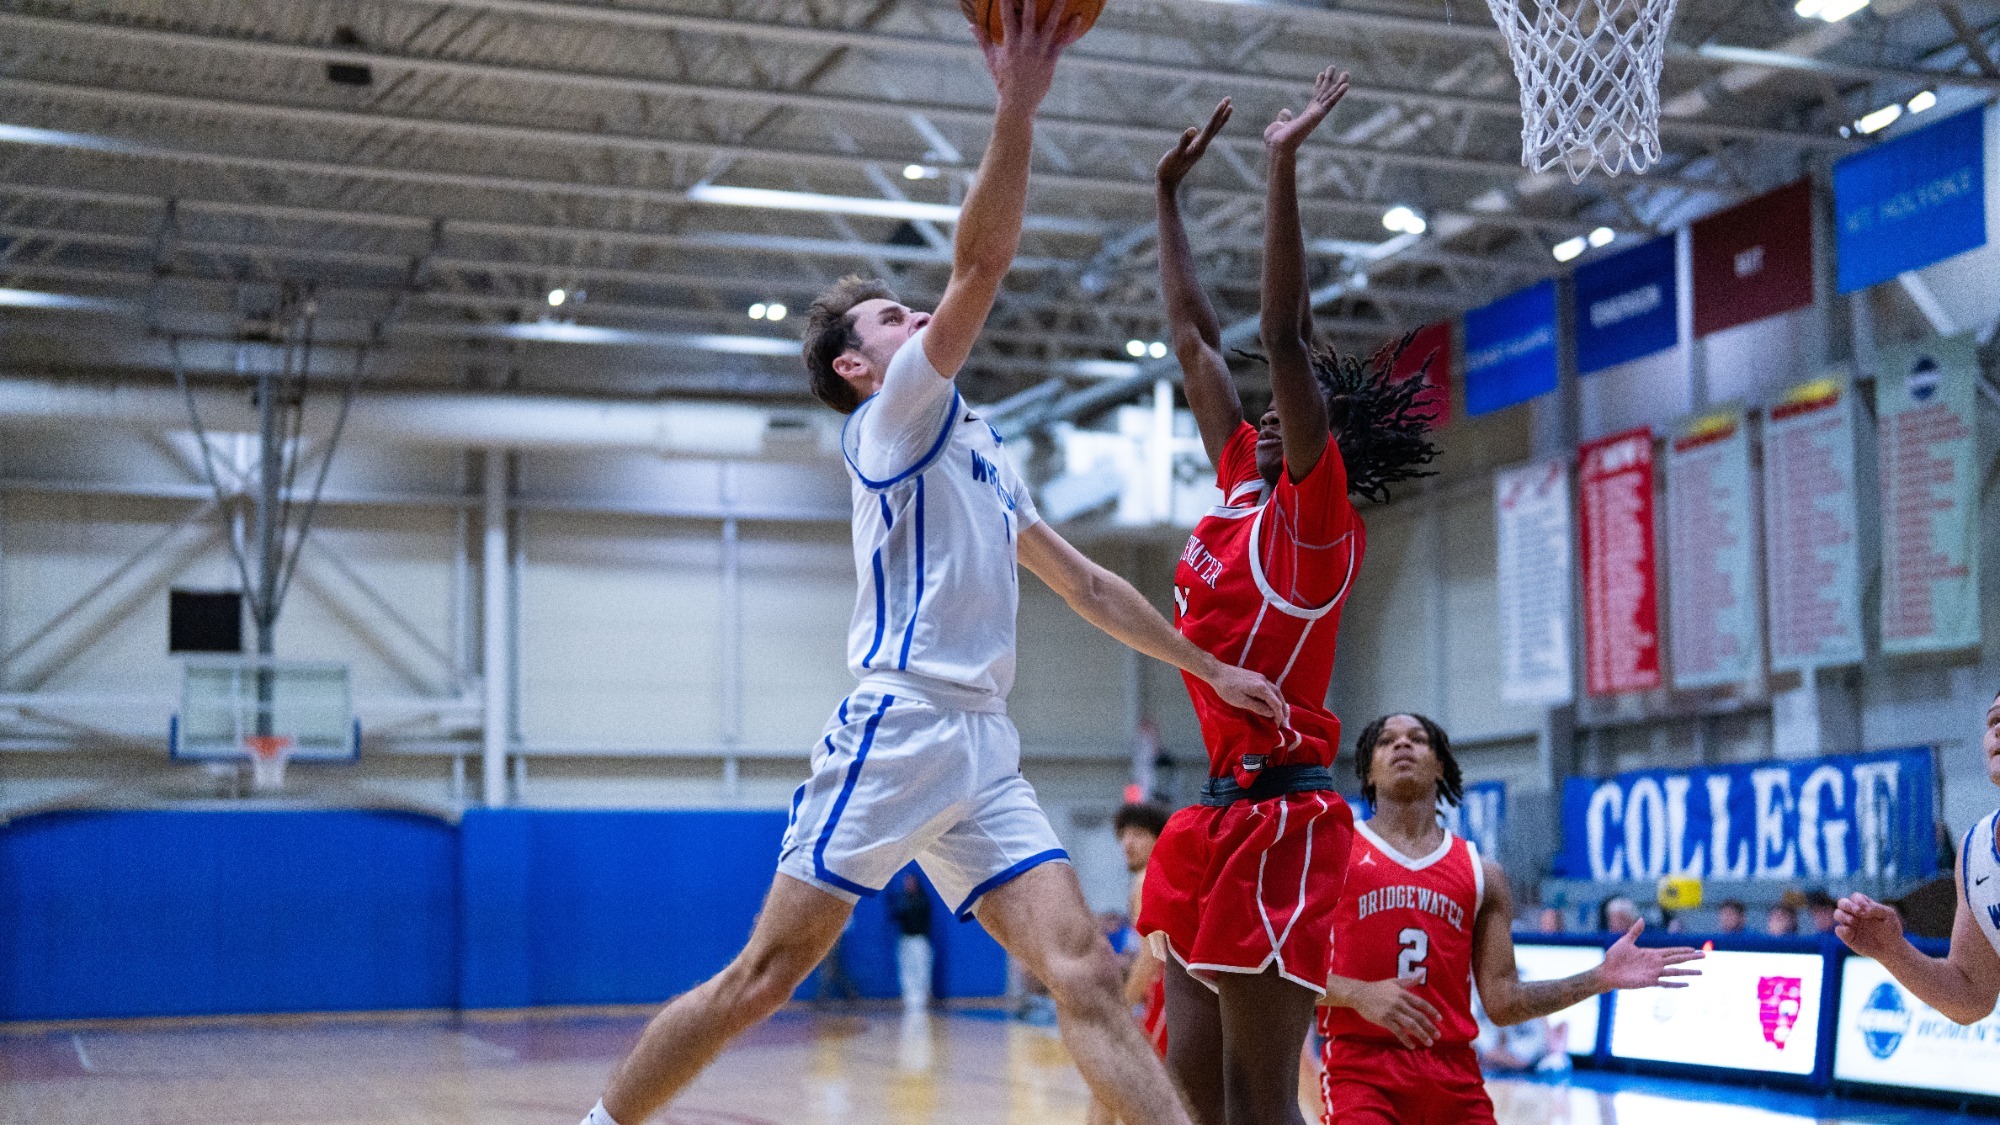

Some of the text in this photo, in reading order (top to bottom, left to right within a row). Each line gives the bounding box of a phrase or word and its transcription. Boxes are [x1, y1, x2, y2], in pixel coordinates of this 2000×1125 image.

[1586, 760, 1900, 883] COLLEGE
[1358, 885, 1464, 932] BRIDGEWATER
[1397, 927, 1429, 986] 2
